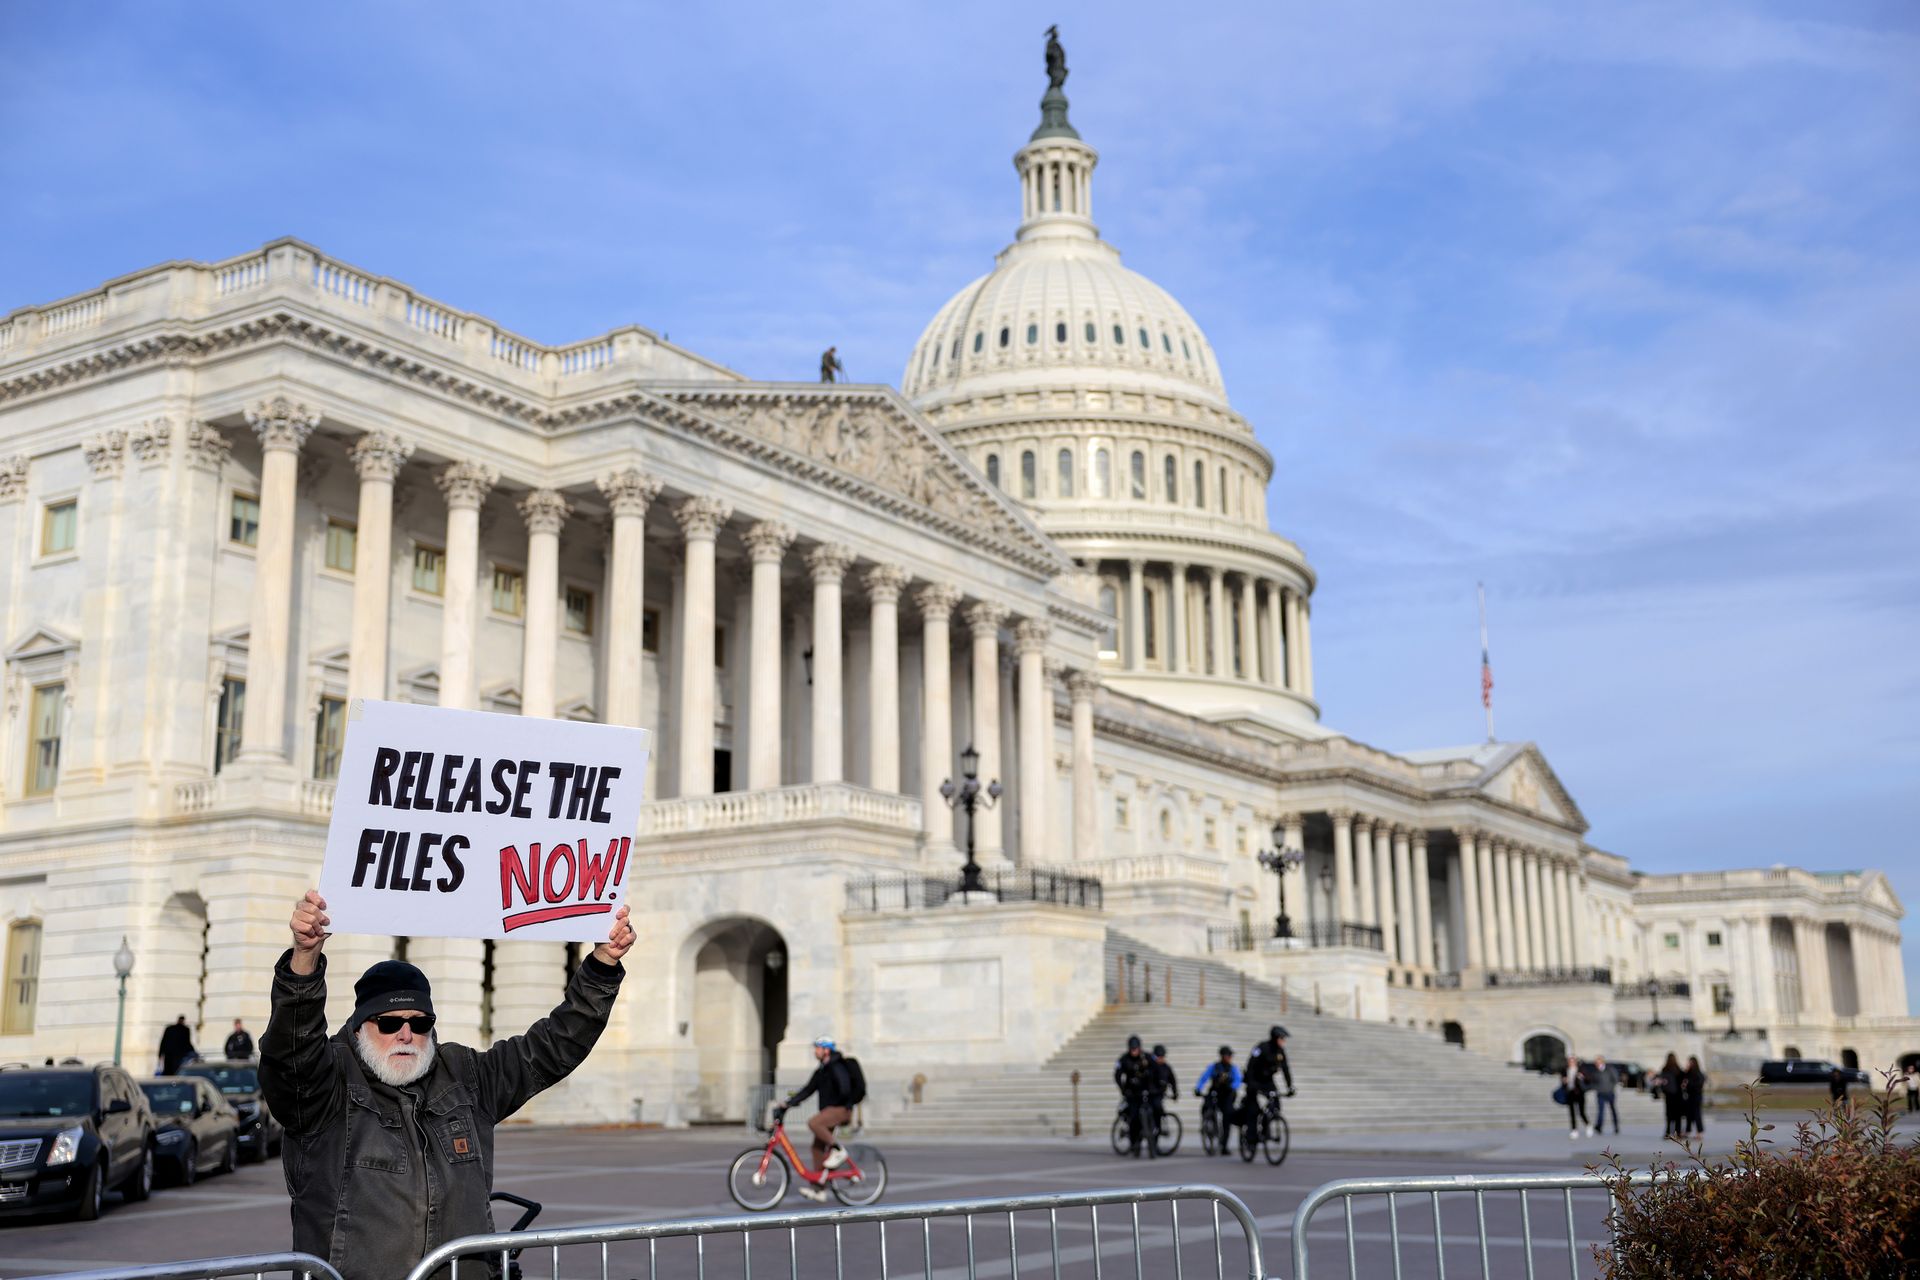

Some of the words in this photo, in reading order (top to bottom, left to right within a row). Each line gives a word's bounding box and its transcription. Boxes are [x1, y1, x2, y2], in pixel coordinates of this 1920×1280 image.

[368, 747, 541, 819] RELEASE
[548, 762, 622, 824] THE
[351, 828, 471, 893] FILES
[499, 836, 632, 911] NOW!
